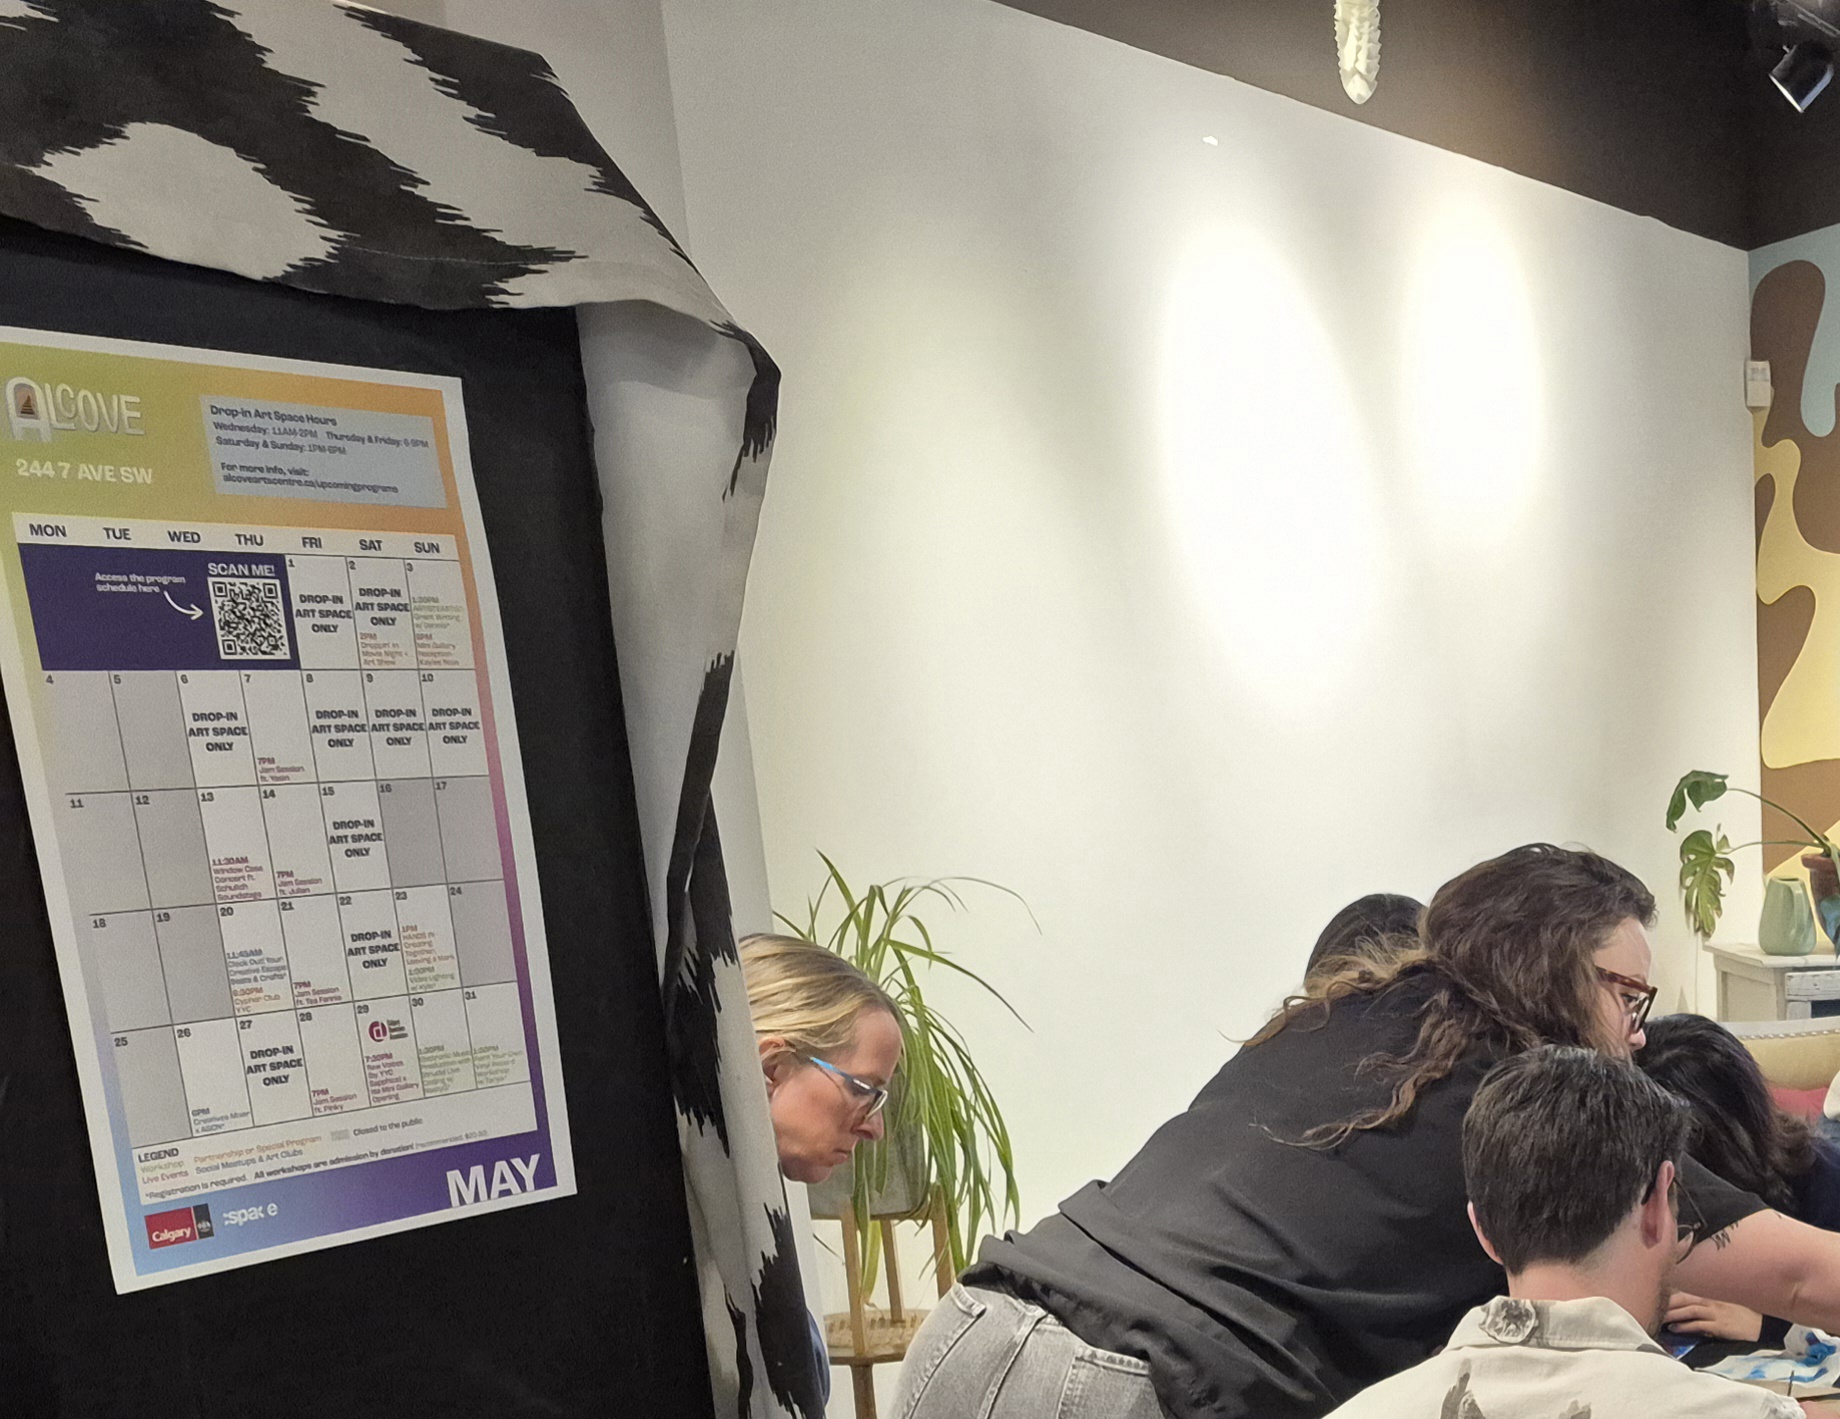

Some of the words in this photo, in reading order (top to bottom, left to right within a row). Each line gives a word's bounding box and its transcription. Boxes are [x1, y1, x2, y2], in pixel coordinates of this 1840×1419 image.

[210, 405, 252, 419] Drop-in
[254, 409, 273, 421] Art
[274, 411, 304, 424] Space
[306, 414, 337, 427] Hours
[213, 421, 270, 436] Wednesday:
[325, 430, 365, 445] Thursday
[367, 434, 374, 444] &
[374, 435, 402, 448] Friday:
[215, 436, 260, 450] Saturday
[262, 439, 269, 449] &
[270, 440, 306, 454] Sunday:
[15, 458, 55, 478] 244
[57, 461, 71, 479] 7
[78, 463, 117, 483] AVE
[119, 466, 153, 485] SW
[220, 462, 237, 472] For
[239, 464, 264, 473] more
[266, 464, 286, 476] info,
[288, 466, 309, 477] visit:
[29, 523, 67, 538] MON
[103, 527, 132, 541] TUE
[167, 530, 201, 544] WED
[235, 533, 264, 546] THU
[301, 537, 322, 549] FRI
[359, 539, 382, 551] SAT
[414, 542, 440, 554] SUN
[288, 558, 295, 567] 1
[349, 560, 356, 570] 2
[406, 563, 414, 572] 3
[207, 562, 249, 576] SCAN
[252, 564, 275, 577] ME!
[95, 572, 127, 582] Access
[130, 573, 145, 582] the
[146, 576, 186, 585] program
[96, 583, 137, 592] schedule
[138, 584, 160, 593] here
[359, 588, 401, 598] DROP-IN
[299, 594, 343, 604] DROP-IN
[354, 602, 376, 612] ART
[377, 602, 410, 612] SPACE
[295, 609, 316, 619] ART
[318, 609, 352, 619] SPACE
[370, 617, 397, 626] ONLY
[311, 624, 338, 633] ONLY
[46, 673, 53, 684] 4
[113, 675, 121, 684] 5
[180, 674, 188, 684] 6
[244, 674, 251, 682] 7
[306, 674, 313, 683] 8
[366, 674, 373, 683] 9
[422, 673, 434, 682] 10
[192, 712, 238, 722] DROP-IN
[315, 710, 359, 720] DROP-IN
[375, 709, 416, 718] DROP-IN
[432, 708, 472, 717] DROP-IN
[311, 724, 332, 734] ART
[333, 723, 367, 733] SPACE
[371, 723, 390, 732] ART
[392, 722, 425, 732] SPACE
[428, 721, 448, 731] ART
[449, 721, 480, 730] SPACE
[188, 727, 209, 737] ART
[212, 726, 248, 736] SPACE
[328, 738, 354, 748] ONLY
[386, 737, 412, 746] ONLY
[443, 735, 467, 744] ONLY
[206, 742, 233, 751] ONLY
[257, 757, 275, 765] 7PM
[379, 783, 392, 793] 16
[435, 781, 447, 790] 17
[263, 789, 276, 799] 14
[322, 786, 334, 796] 15
[135, 795, 150, 805] 12
[200, 792, 214, 802] 13
[70, 799, 84, 808] 11
[333, 819, 375, 830] DROP-IN
[329, 835, 349, 845] ART
[351, 833, 383, 843] SPACE
[344, 847, 371, 858] ONLY
[276, 870, 294, 878] 7PM
[395, 891, 407, 900] 23
[450, 887, 462, 895] 24
[339, 896, 352, 905] 22
[220, 906, 234, 916] 20
[281, 902, 294, 911] 21
[156, 913, 170, 922] 19
[92, 919, 106, 929] 18
[350, 930, 391, 942] DROP-IN
[347, 946, 366, 957] ART
[368, 943, 400, 954] SPACE
[362, 958, 388, 969] ONLY
[293, 981, 311, 989] 7PM
[465, 991, 477, 1000] 31
[412, 998, 424, 1007] 30
[357, 1005, 369, 1014] 29
[299, 1012, 312, 1022] 28
[239, 1020, 252, 1030] 27
[177, 1028, 191, 1038] 26
[114, 1036, 128, 1047] 25
[250, 1045, 295, 1059] DROP-IN
[246, 1064, 267, 1074] ART
[269, 1058, 303, 1070] SPACE
[263, 1075, 290, 1086] ONLY
[312, 1088, 329, 1097] 7PM
[353, 1125, 378, 1137] Closed
[388, 1122, 400, 1130] the
[402, 1117, 423, 1128] public
[193, 1149, 244, 1164] Partnership
[245, 1148, 255, 1156] or
[256, 1141, 285, 1154] Special
[286, 1136, 322, 1148] Program
[138, 1148, 179, 1163] LEGEND
[195, 1163, 220, 1174] Social
[221, 1157, 257, 1171] Meetups
[258, 1155, 265, 1164] &
[266, 1152, 279, 1162] Art
[280, 1148, 303, 1159] Clubs
[254, 1170, 265, 1180] All
[266, 1162, 312, 1178] workshops
[314, 1159, 328, 1168] are
[329, 1152, 369, 1166] admission
[369, 1149, 379, 1160] by
[140, 1160, 184, 1173] Workshop
[142, 1174, 160, 1184] Live
[161, 1169, 189, 1181] Events
[446, 1153, 541, 1208] MAY
[201, 1182, 209, 1190] is
[210, 1174, 249, 1188] required.
[152, 1226, 191, 1242] Calgary
